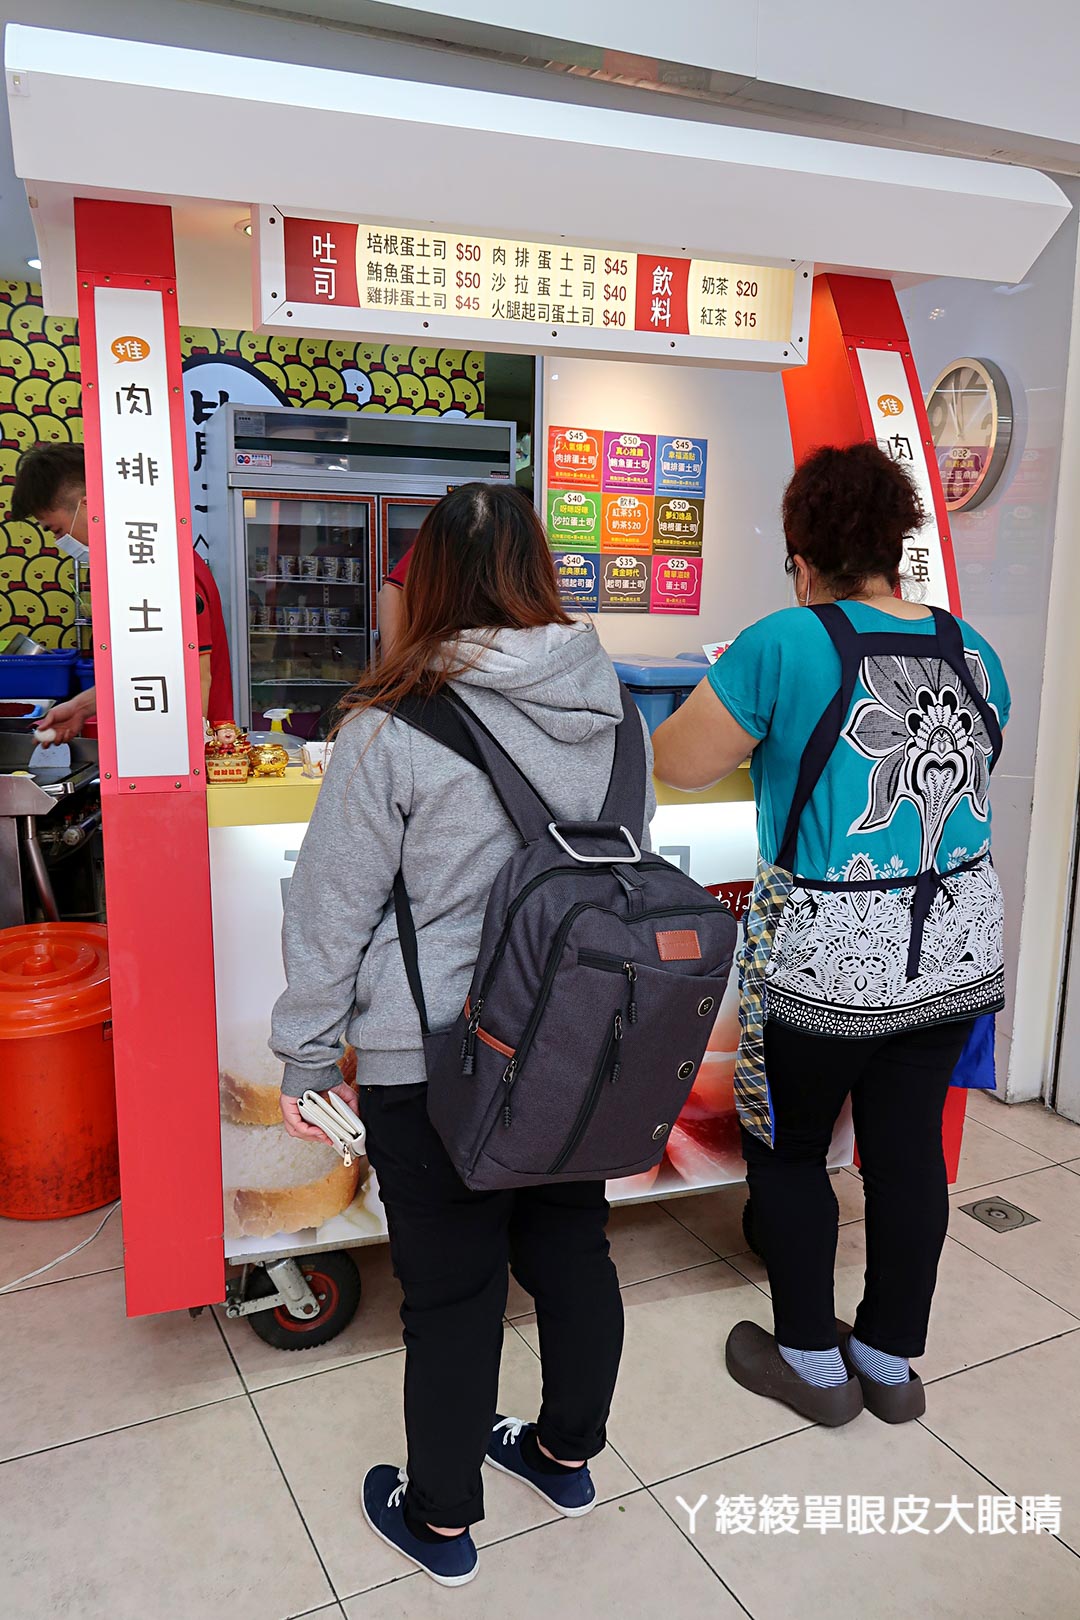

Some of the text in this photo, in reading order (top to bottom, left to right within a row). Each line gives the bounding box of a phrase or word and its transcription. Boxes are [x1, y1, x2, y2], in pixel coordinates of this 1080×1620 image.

[366, 232, 482, 263] 培根蛋土司 $50
[312, 233, 338, 301] 吐司
[492, 246, 629, 276] 肉排蛋土司 $45
[366, 260, 481, 289] 鮪魚蛋土司 $50
[491, 272, 627, 302] 沙拉蛋土司 $40
[650, 265, 673, 328] 飲料
[701, 275, 759, 298] 奶茶 $20
[366, 286, 480, 311] 雞排蛋土司 $45
[491, 298, 626, 328] 火腿起司蛋土司 $40
[700, 306, 757, 328] 紅茶 $15
[114, 340, 144, 361] 推
[879, 397, 900, 416] 推
[569, 431, 584, 441] $45
[623, 436, 638, 446] $50
[675, 440, 690, 450] $45
[567, 493, 583, 503] $40
[618, 497, 636, 507] 飲料
[672, 501, 687, 511] $50
[554, 515, 594, 528] 沙拉蛋土司
[115, 383, 169, 714] 肉排蛋土司
[566, 556, 582, 566] $40
[618, 557, 634, 567] $35
[670, 559, 685, 569] $25
[665, 580, 689, 591] 蛋土司
